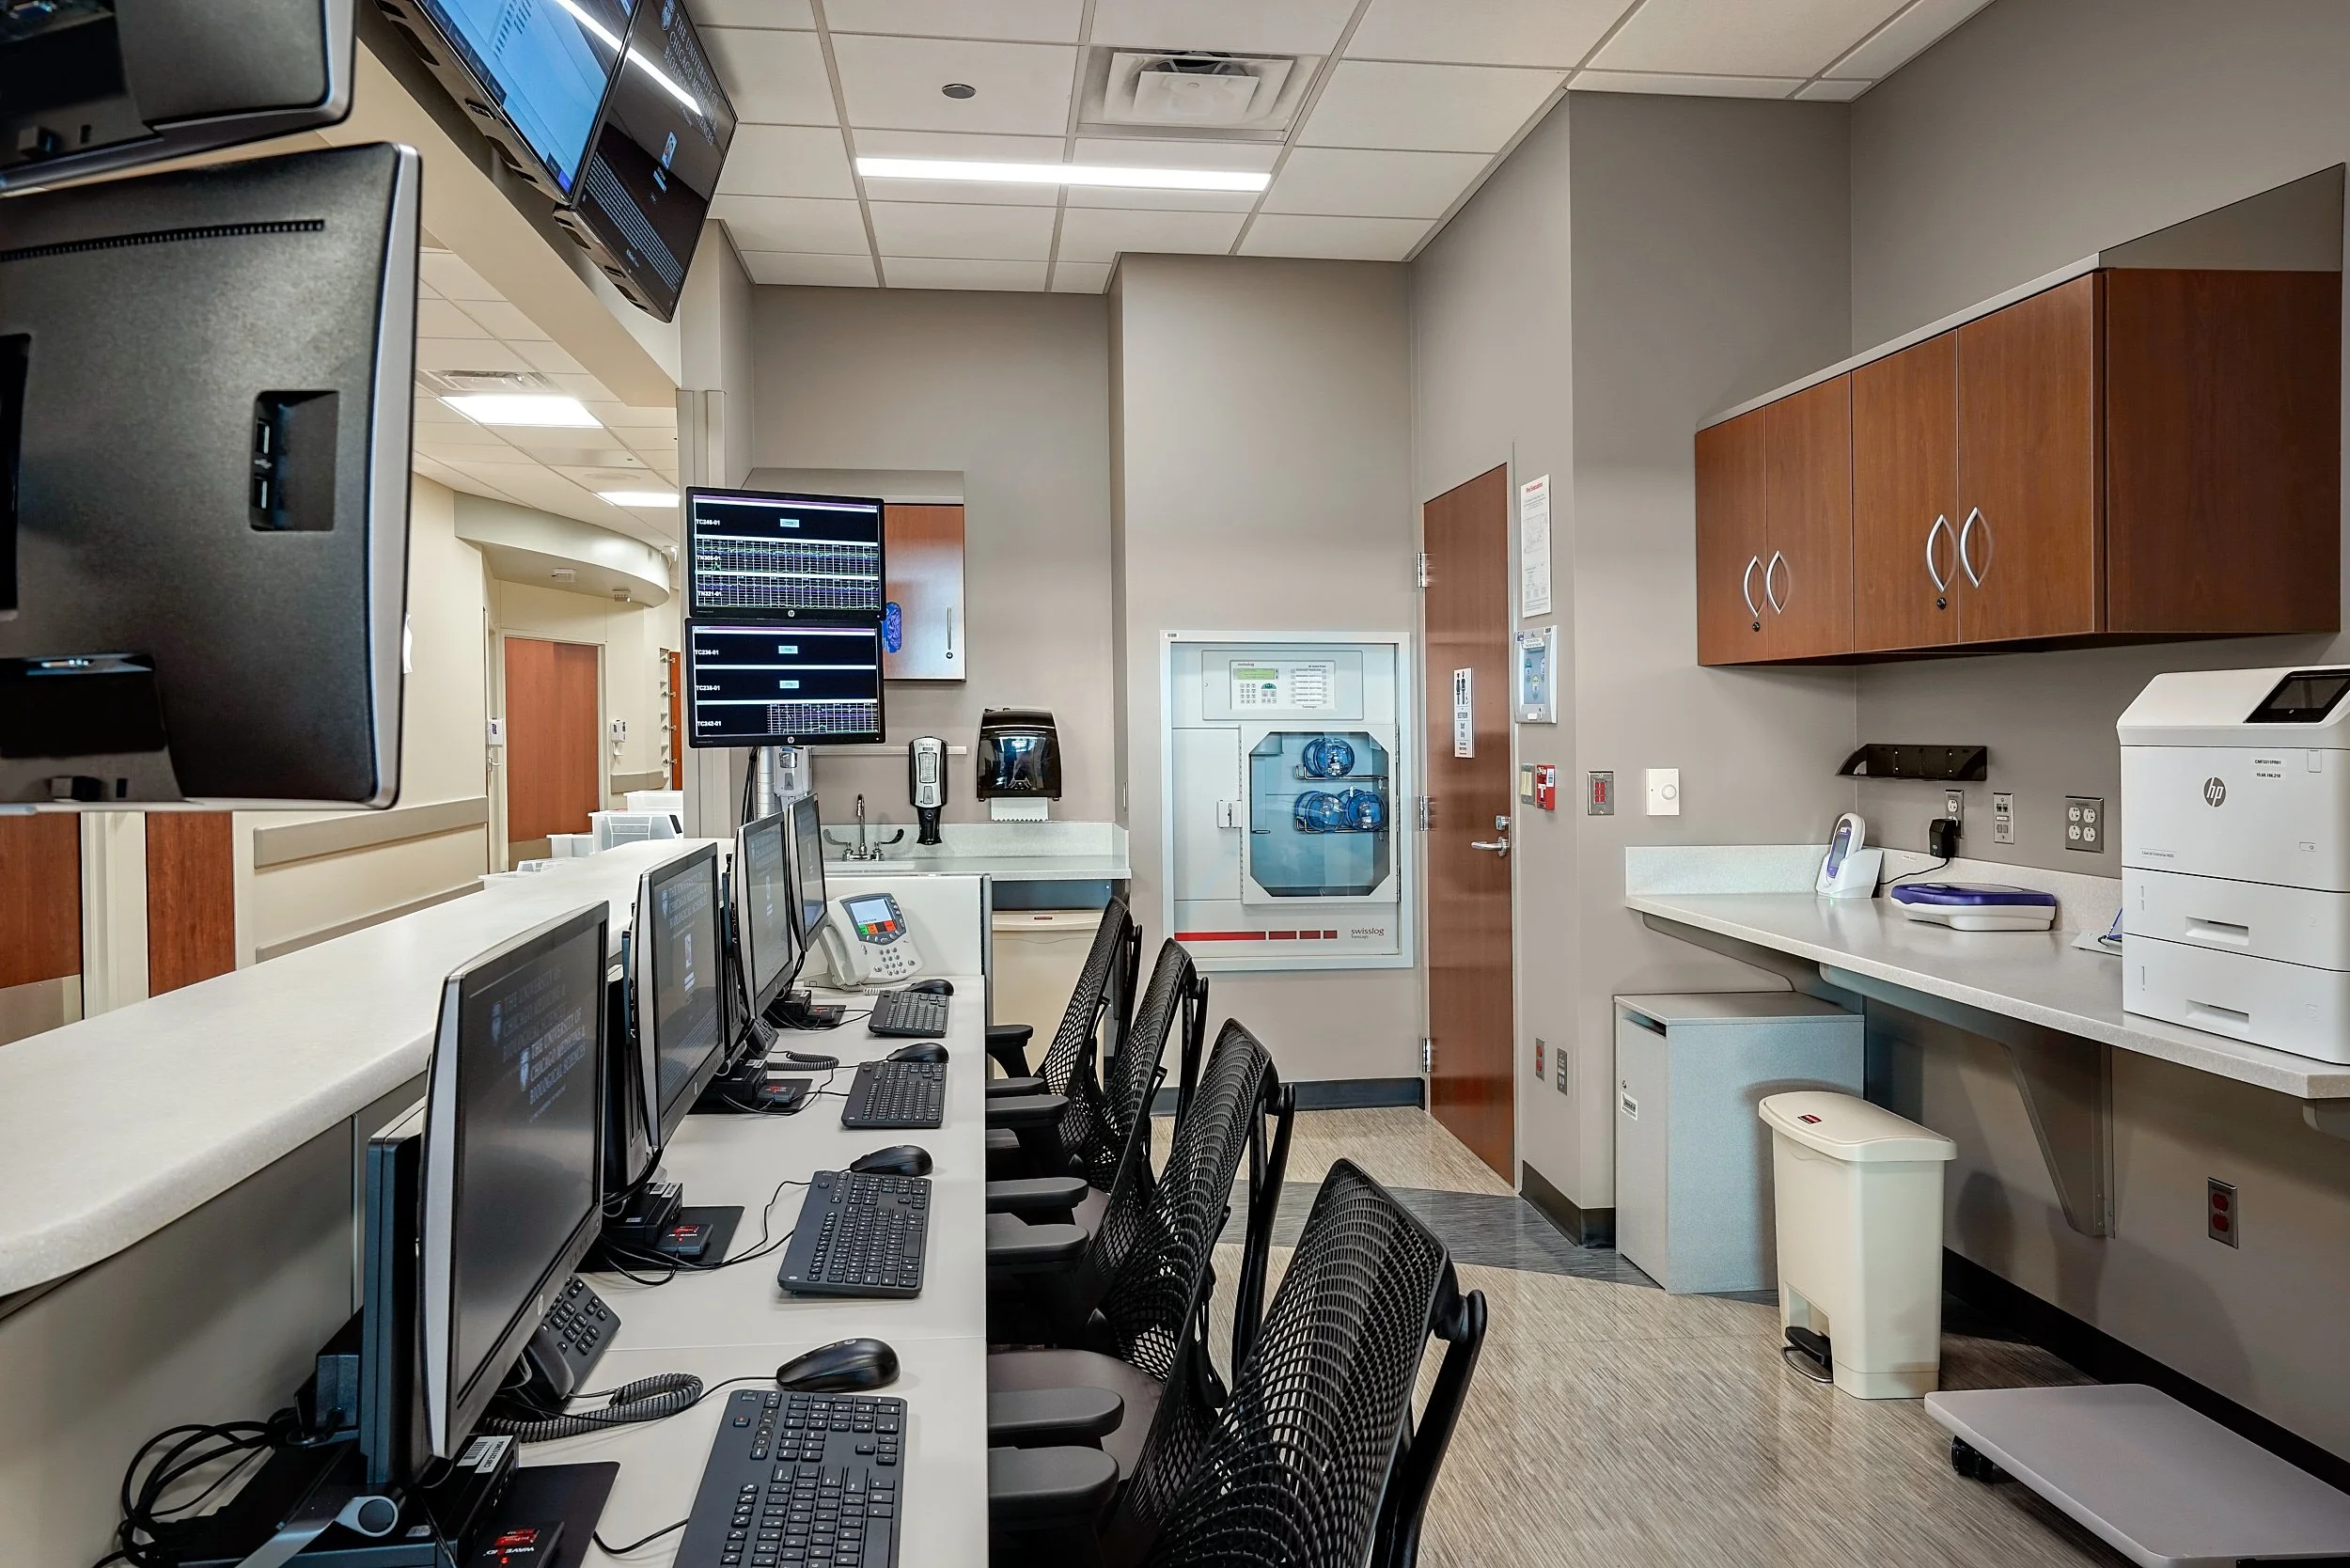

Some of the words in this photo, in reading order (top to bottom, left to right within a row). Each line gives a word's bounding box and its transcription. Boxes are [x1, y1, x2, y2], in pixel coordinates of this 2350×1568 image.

[669, 31, 694, 80] CHICAGO
[691, 76, 716, 125] MEDICINE
[674, 13, 687, 42] THE
[686, 37, 713, 95] UNIVERSITY
[711, 93, 720, 109] OF
[2207, 777, 2224, 807] hp
[1351, 927, 1384, 936] swisslog
